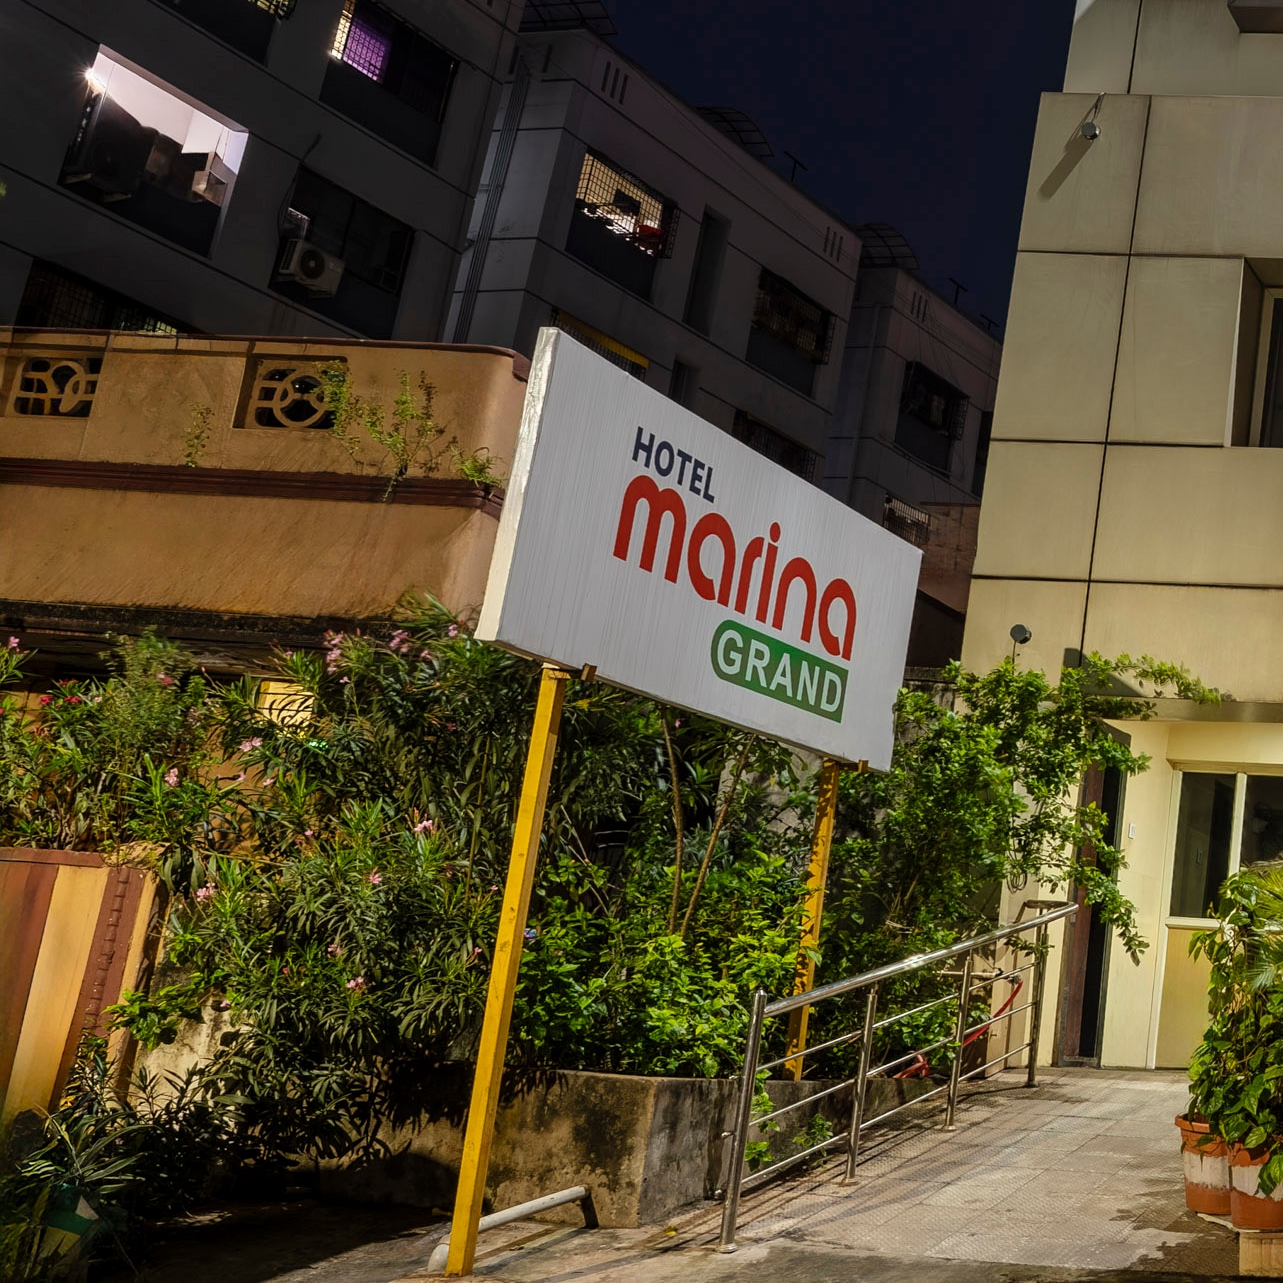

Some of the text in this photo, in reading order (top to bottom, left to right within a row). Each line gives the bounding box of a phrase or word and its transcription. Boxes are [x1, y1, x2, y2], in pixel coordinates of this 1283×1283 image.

[631, 426, 715, 503] HOTEL
[613, 475, 856, 661] marina
[717, 629, 842, 713] GRAND
